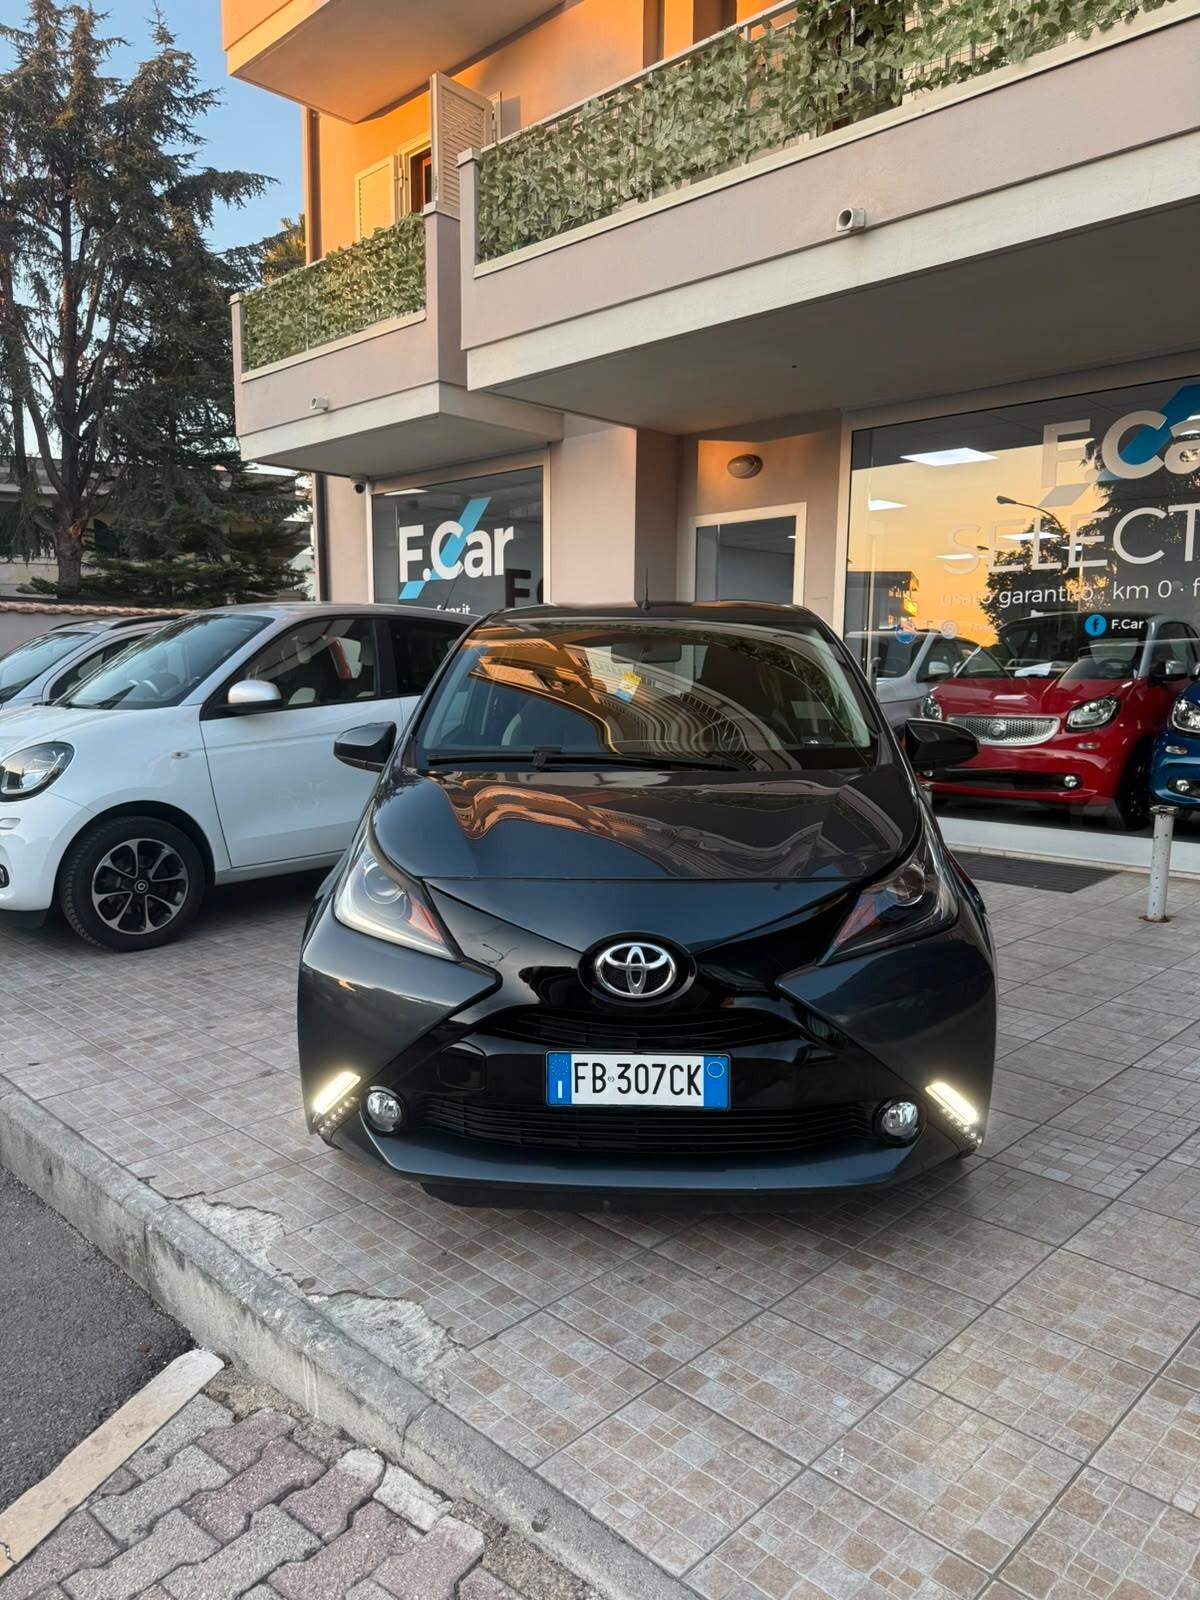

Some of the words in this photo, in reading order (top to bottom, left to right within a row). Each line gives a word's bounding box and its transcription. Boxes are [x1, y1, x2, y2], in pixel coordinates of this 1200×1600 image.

[399, 520, 514, 583] F.Car
[1112, 581, 1149, 600] km
[1157, 579, 1172, 598] 0
[1111, 619, 1145, 630] F.Car
